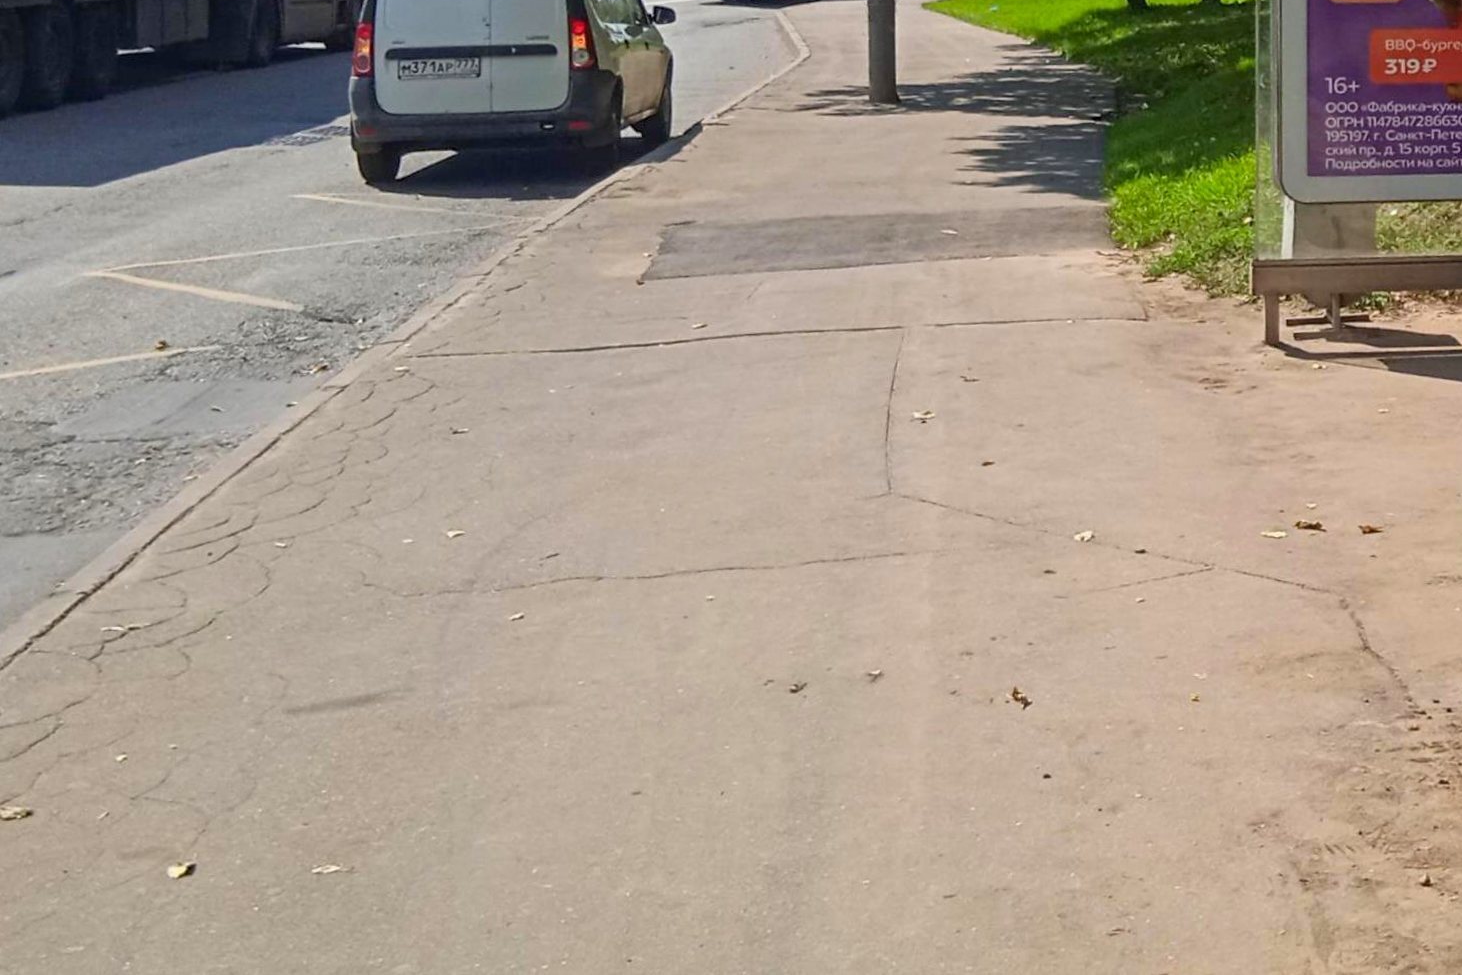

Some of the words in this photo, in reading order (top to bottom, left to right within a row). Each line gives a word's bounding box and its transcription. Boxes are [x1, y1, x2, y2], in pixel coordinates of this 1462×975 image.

[1324, 77, 1360, 95] 16+
[1325, 101, 1359, 114] ООО
[1325, 116, 1364, 129] ОГРН
[1325, 145, 1357, 157] ский
[1398, 143, 1413, 155] 15
[1451, 142, 1461, 154] 5
[1325, 157, 1415, 171] Подробности
[1416, 159, 1434, 168] на
